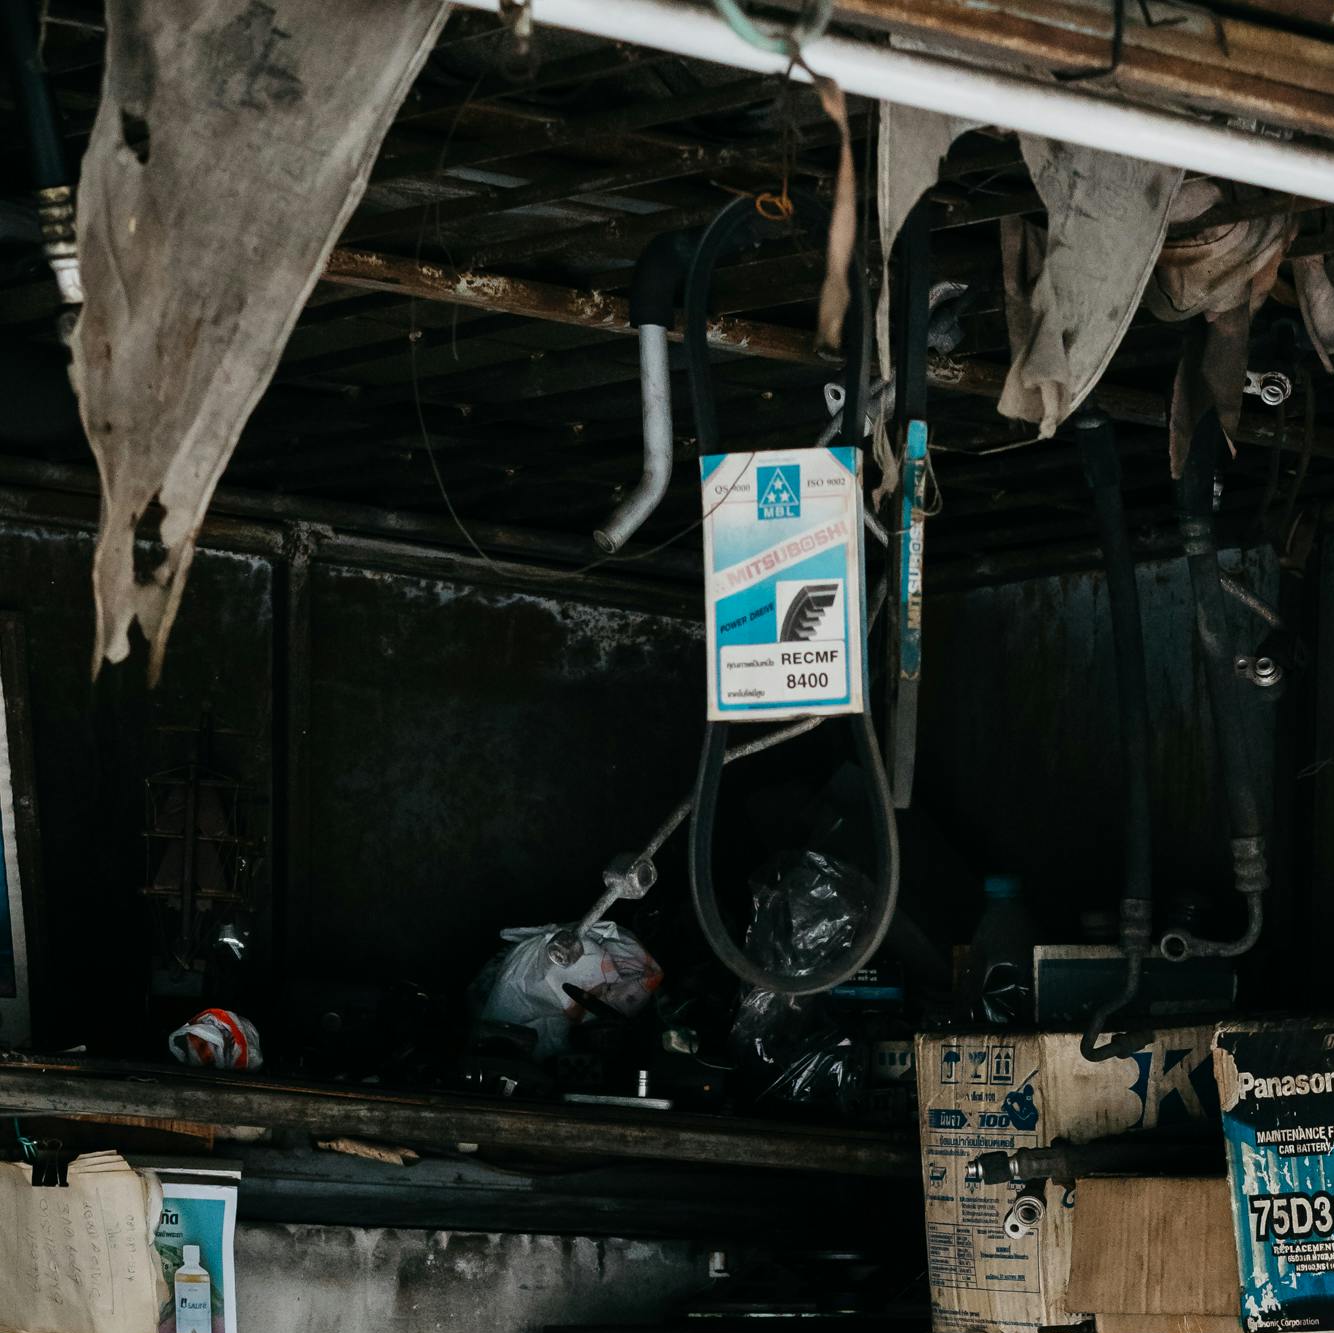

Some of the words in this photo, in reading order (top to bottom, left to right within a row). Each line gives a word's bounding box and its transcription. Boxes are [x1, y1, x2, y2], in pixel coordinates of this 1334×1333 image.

[807, 479, 824, 489] ISO
[763, 507, 795, 519] MBL
[725, 520, 849, 588] MITSUBOSHI
[719, 615, 748, 635] POWER
[781, 650, 839, 666] RECMF
[786, 672, 829, 690] 8400
[978, 1113, 1010, 1128] 100
[1256, 1126, 1327, 1144] MAINTENANCE
[1278, 1144, 1295, 1155] CAR
